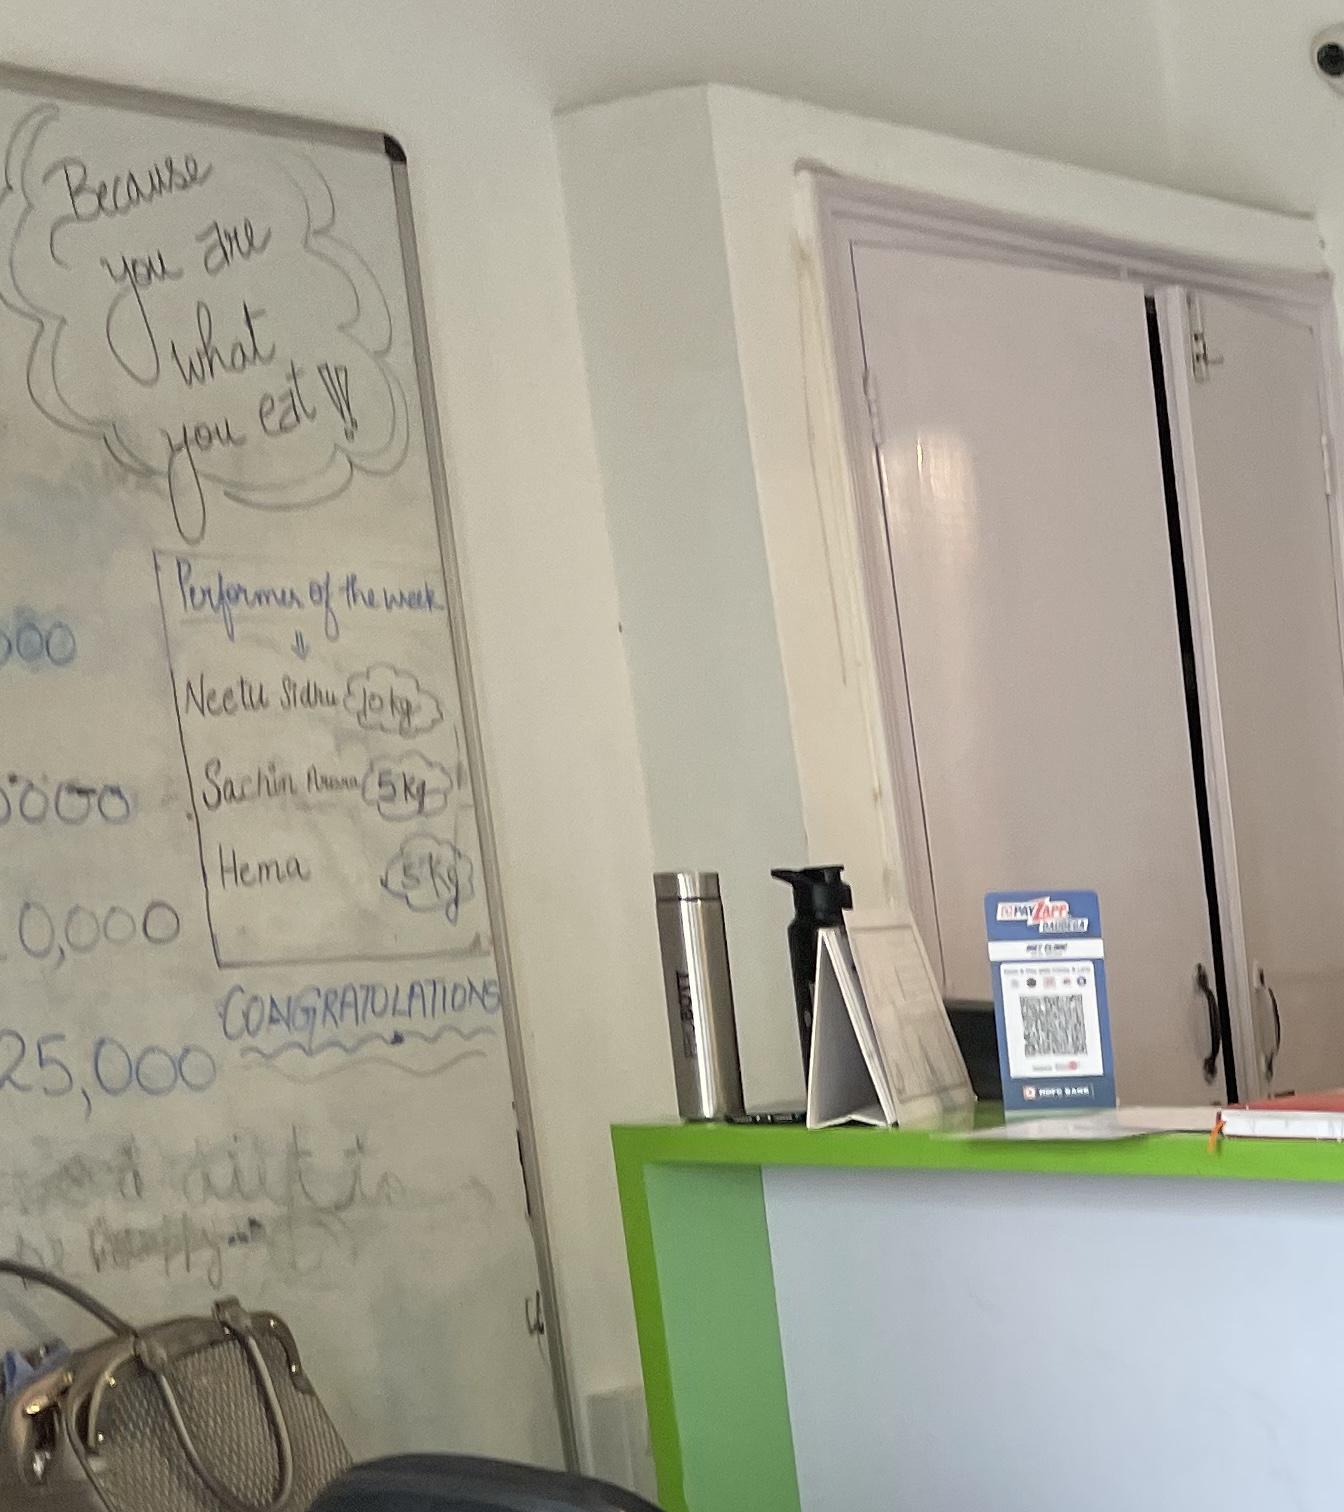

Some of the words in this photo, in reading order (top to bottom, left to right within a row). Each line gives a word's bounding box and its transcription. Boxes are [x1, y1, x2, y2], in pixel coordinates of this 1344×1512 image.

[42, 153, 213, 268] Because
[170, 299, 276, 387] what
[308, 571, 340, 642] of
[218, 842, 312, 891] Hema
